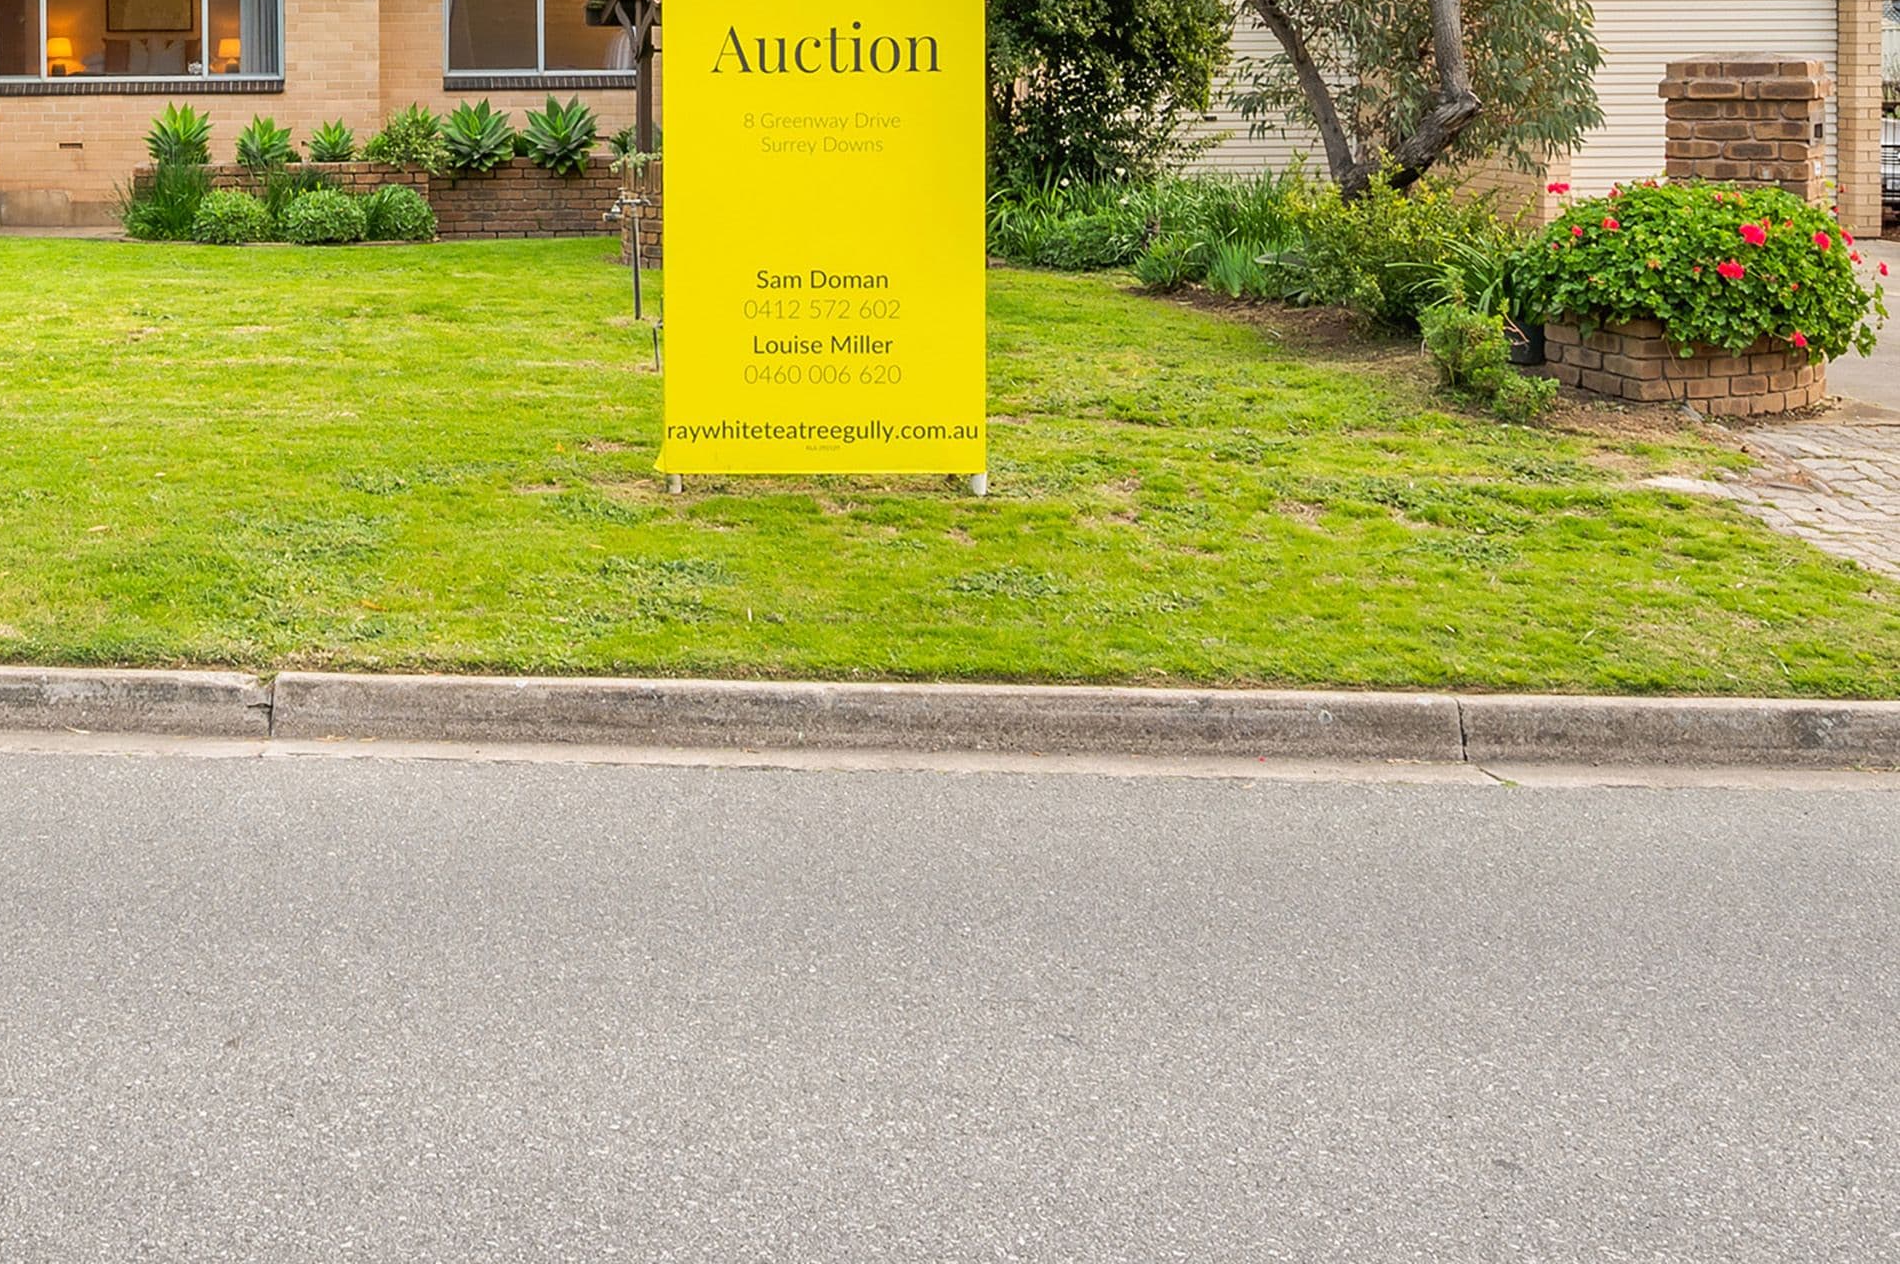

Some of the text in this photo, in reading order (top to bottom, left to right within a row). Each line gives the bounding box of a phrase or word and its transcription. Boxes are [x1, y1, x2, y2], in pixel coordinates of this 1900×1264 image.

[711, 21, 942, 74] Auction
[744, 112, 900, 130] 8 Greenway Drive
[762, 137, 883, 154] Surrey Downs
[757, 270, 888, 289] Sam Doman
[744, 300, 900, 319] 0412 572 602
[754, 335, 893, 354] Louise Miller
[744, 365, 901, 384] 0460 006 620
[668, 420, 978, 442] raywhiteteatreegully.com.au
